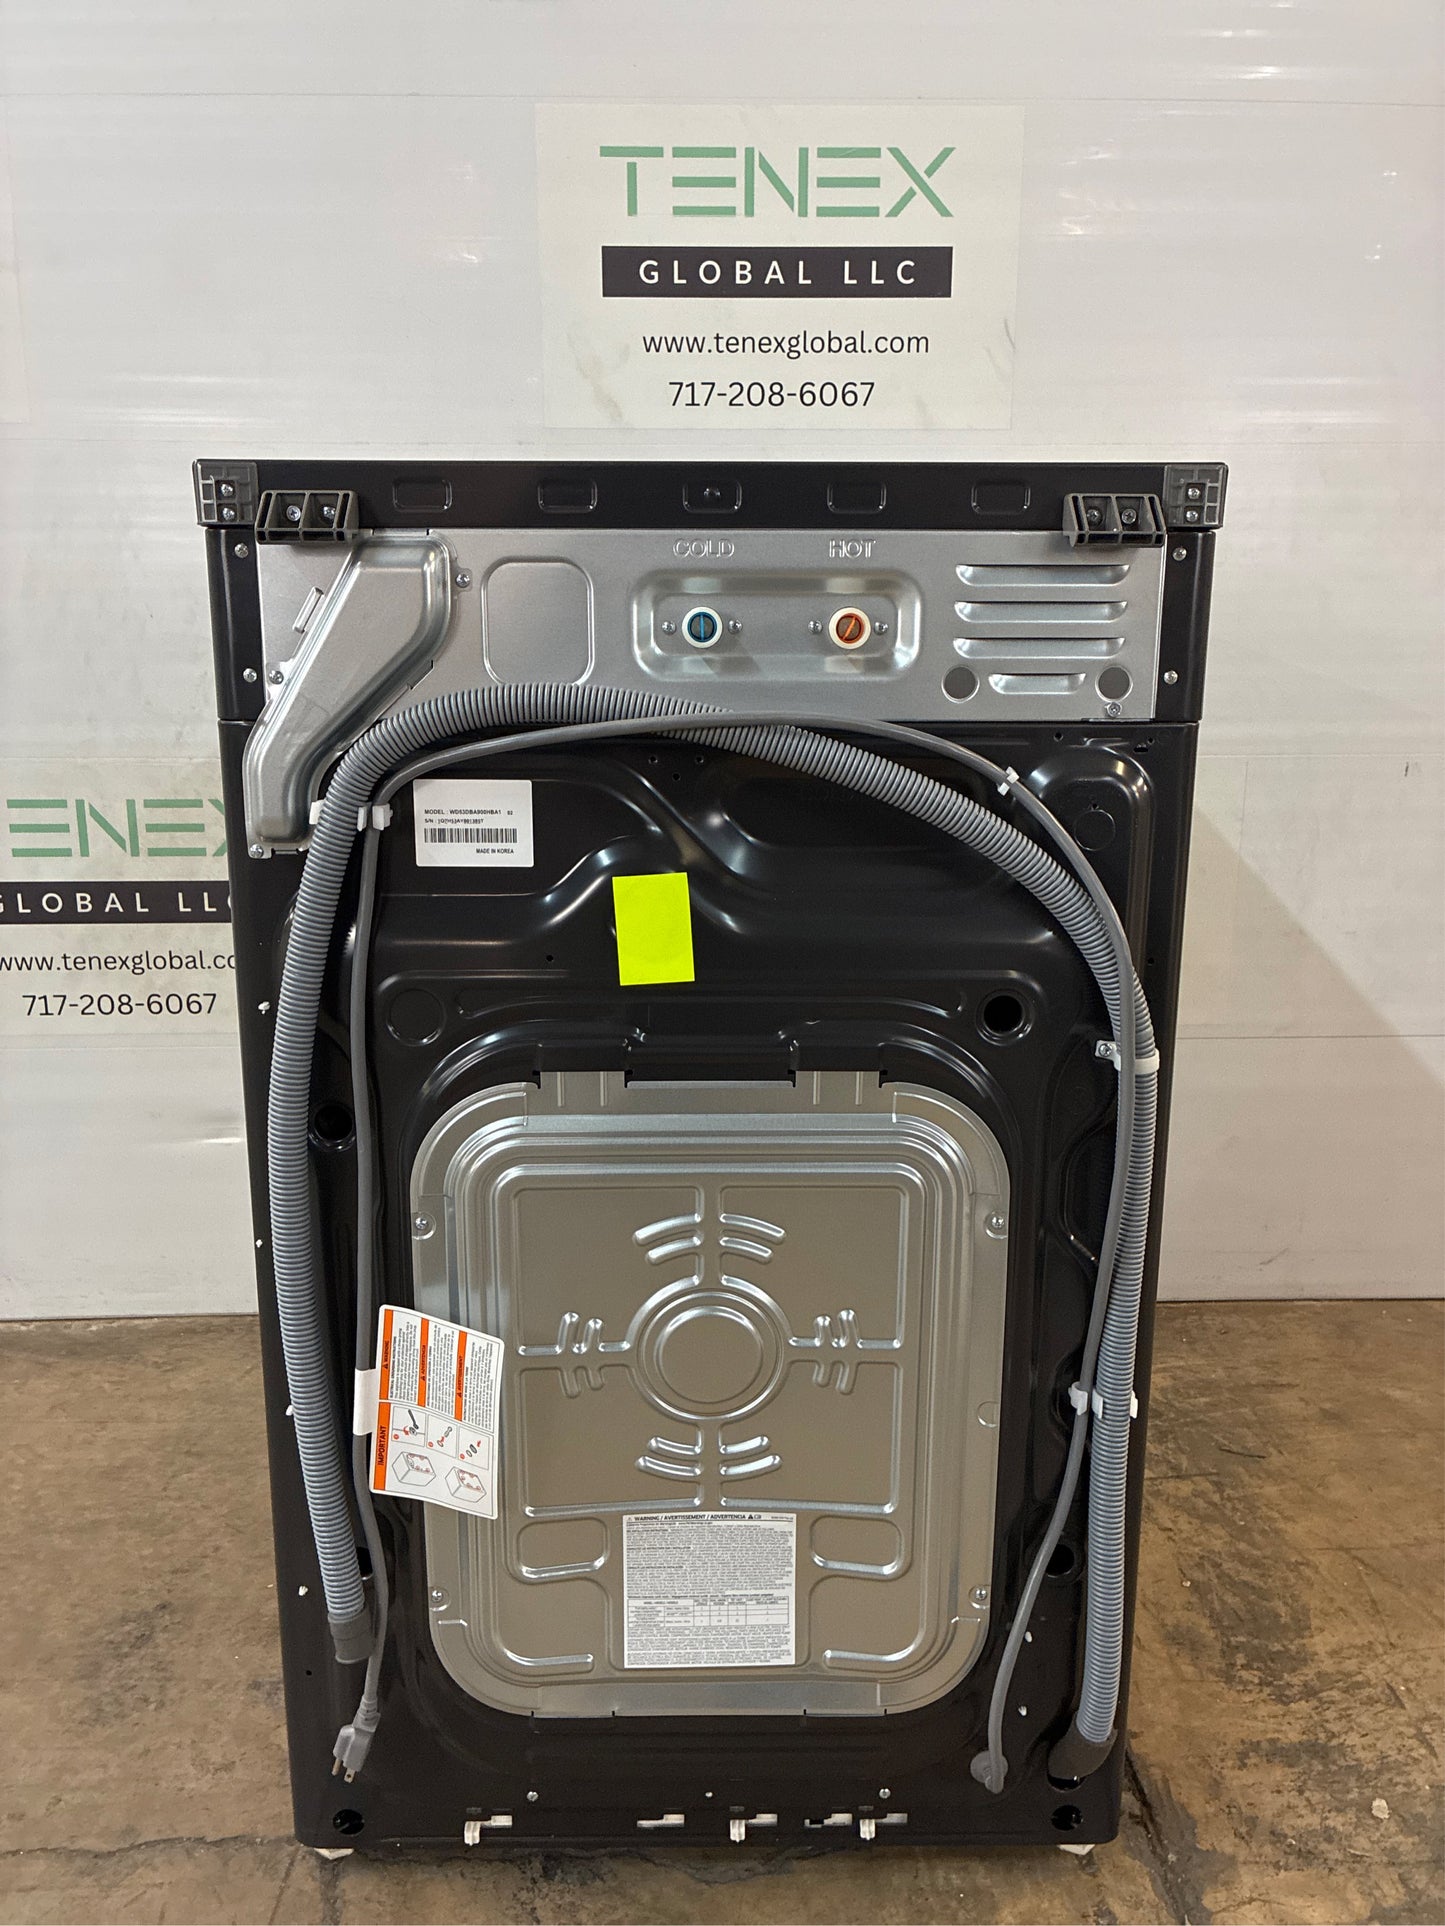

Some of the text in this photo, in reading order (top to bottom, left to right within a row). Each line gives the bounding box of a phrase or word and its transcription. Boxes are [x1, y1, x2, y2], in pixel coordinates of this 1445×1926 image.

[599, 146, 956, 218] TENEX
[639, 260, 918, 285] GLOBAL LLC
[642, 330, 930, 360] www.tenexglobal.com
[669, 381, 876, 407] 717-208-6067
[673, 538, 734, 558] COLD
[829, 538, 876, 559] HOT
[0, 892, 232, 914] LOBAL LL
[22, 993, 217, 1017] 717-208-6067
[377, 1425, 387, 1466] IMPORTANT
